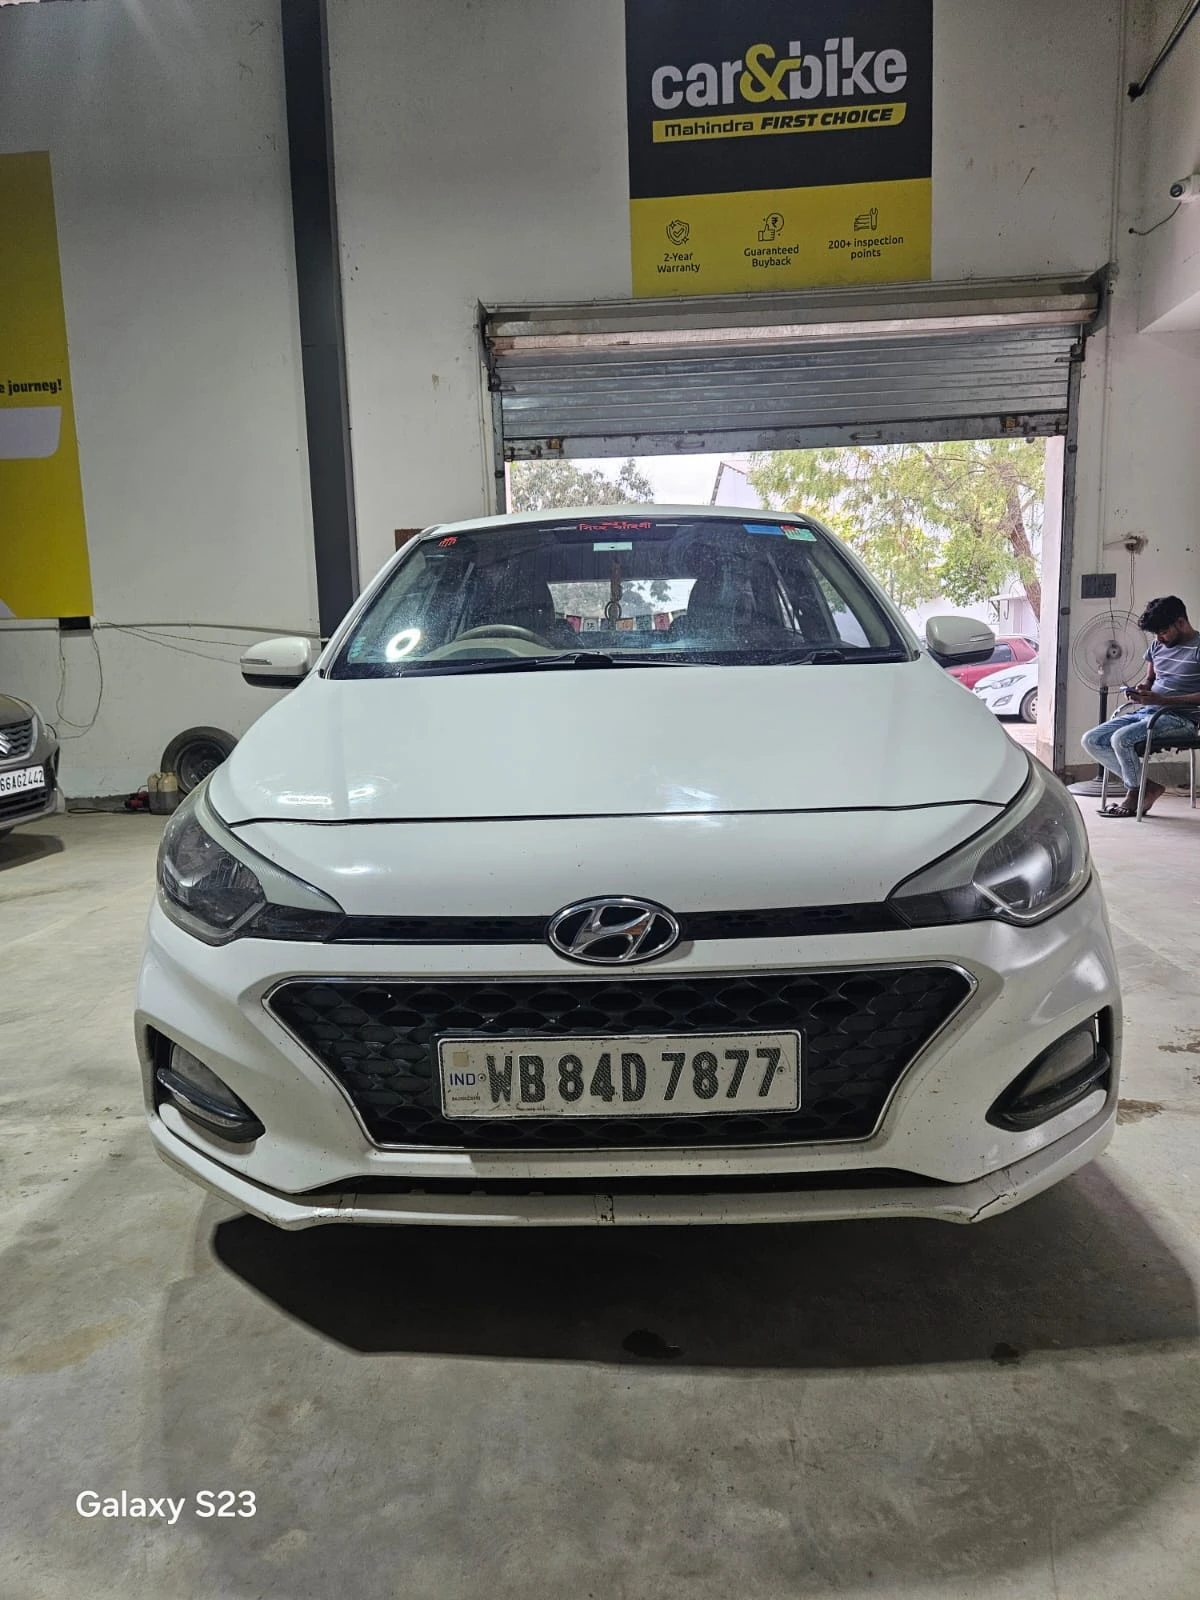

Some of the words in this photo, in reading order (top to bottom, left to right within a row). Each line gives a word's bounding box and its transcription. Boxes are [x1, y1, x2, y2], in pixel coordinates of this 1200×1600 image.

[651, 37, 907, 110] car&bike
[664, 119, 754, 137] Mahindra
[760, 113, 819, 130] FIRST
[820, 108, 894, 126] CHOICE
[828, 239, 851, 249] 200+
[853, 235, 904, 248] inspection
[663, 252, 693, 262] 2-Year
[743, 244, 799, 257] Guaranteed
[850, 248, 881, 260] points
[657, 263, 700, 273] Warranty
[752, 256, 791, 268] Buyback
[8, 378, 62, 395] journey!
[450, 1073, 476, 1086] IND
